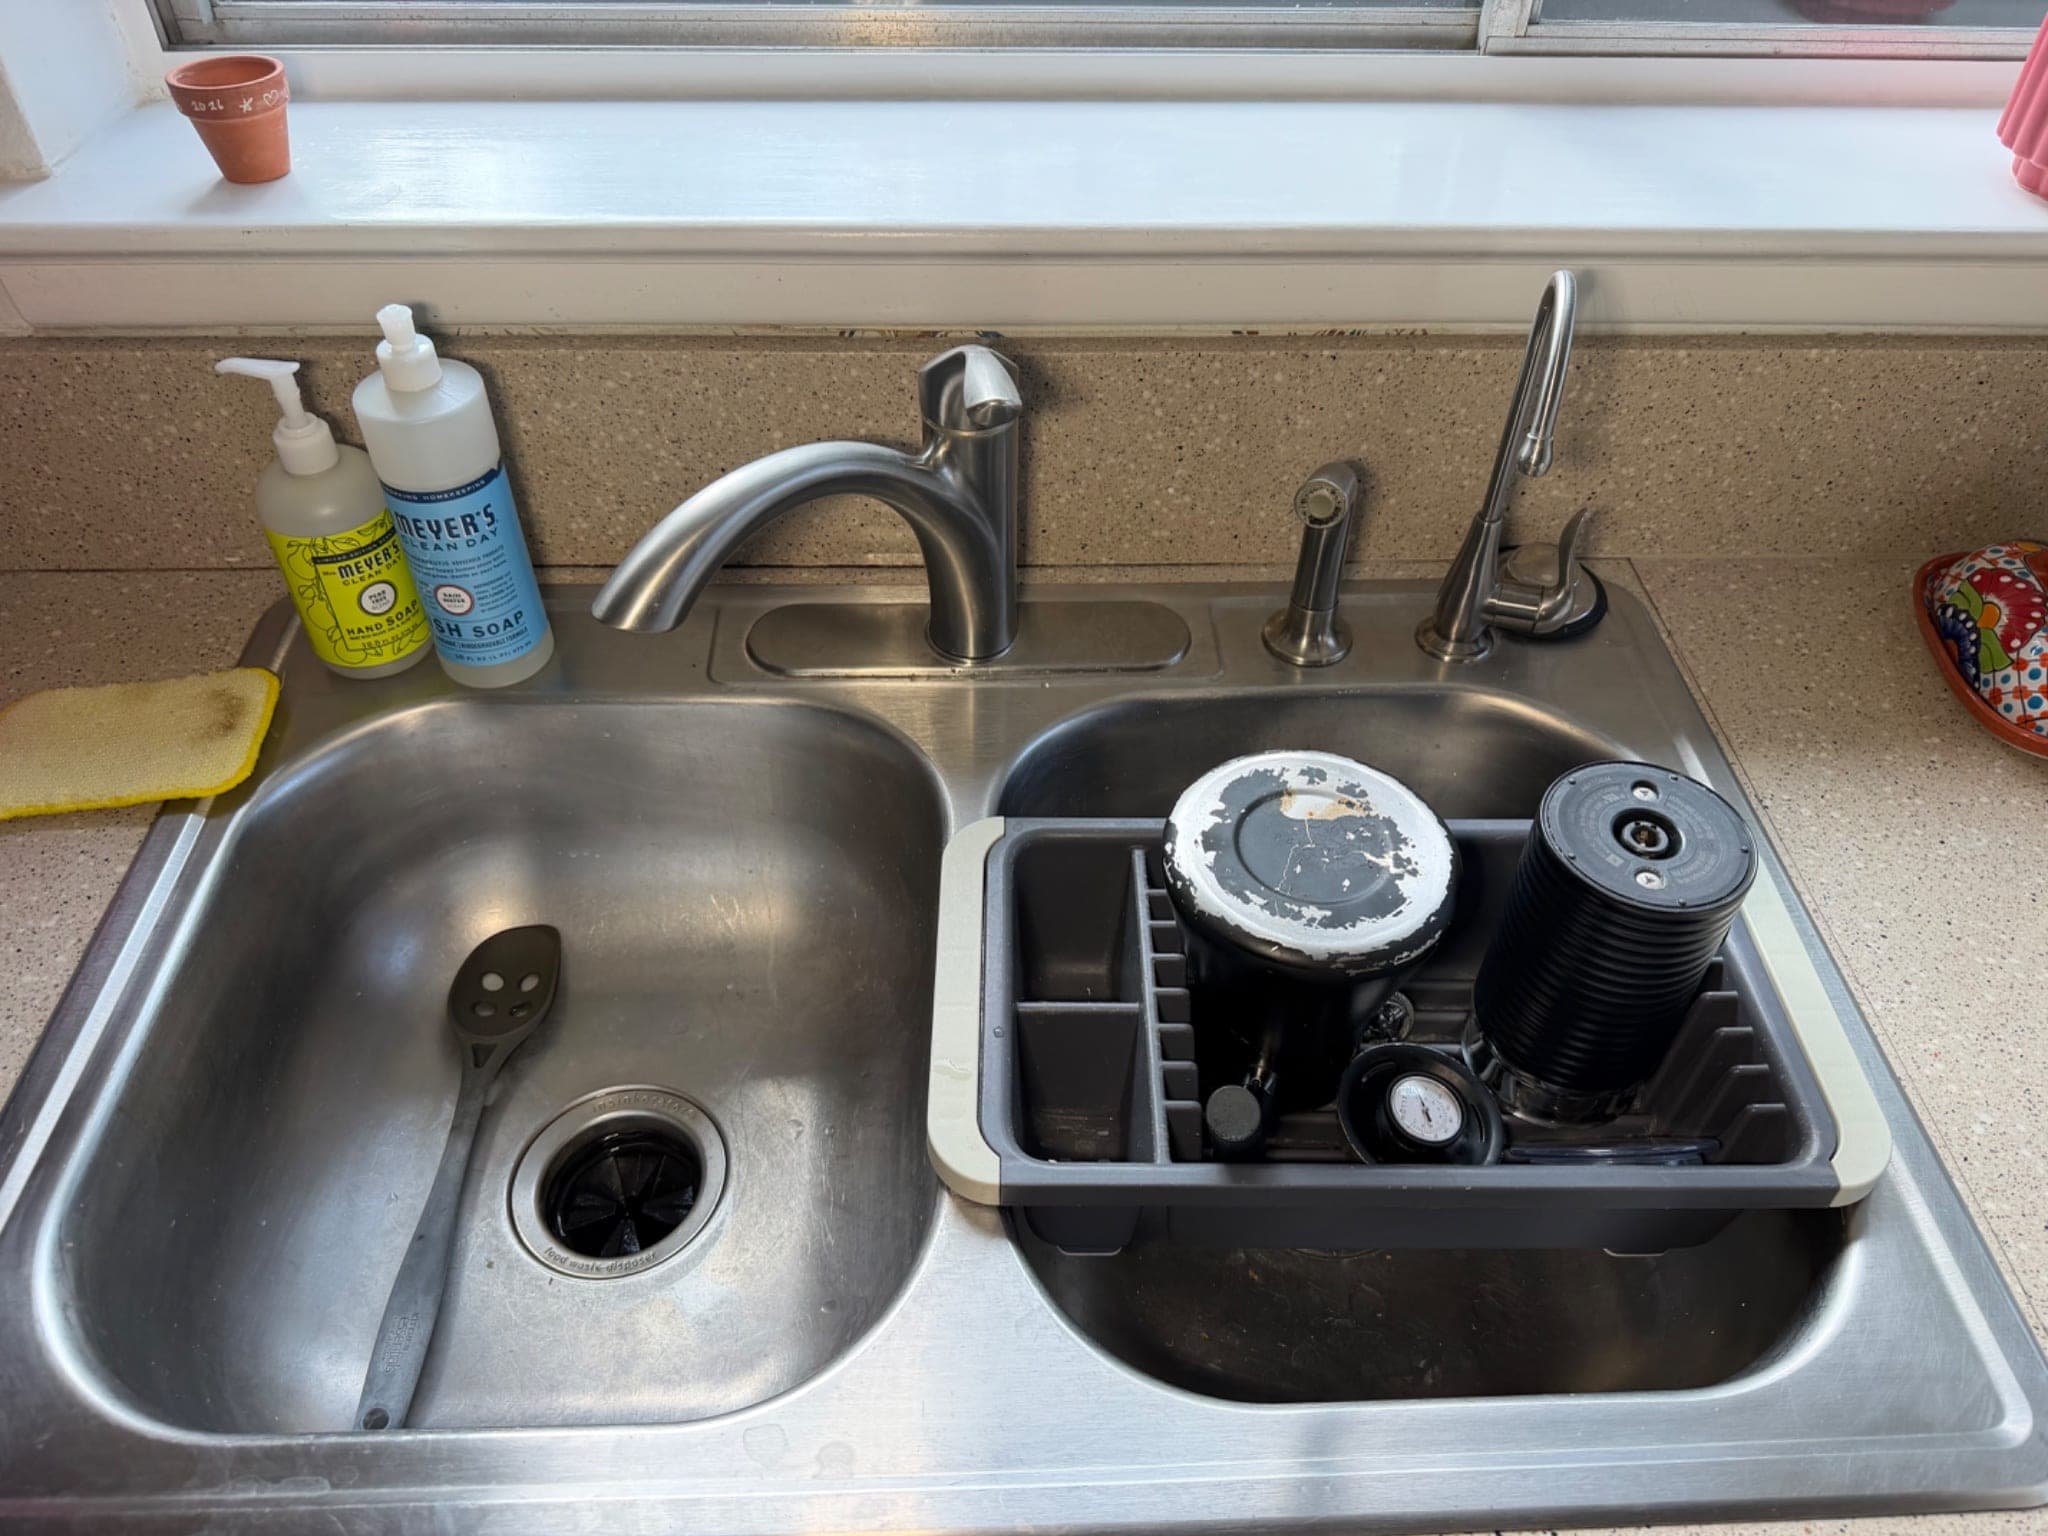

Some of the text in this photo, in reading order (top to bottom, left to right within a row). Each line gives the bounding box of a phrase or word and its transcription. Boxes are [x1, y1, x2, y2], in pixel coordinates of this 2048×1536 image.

[393, 502, 496, 541] MEYER'S
[400, 534, 458, 553] CLEAN
[466, 527, 498, 547] DAY
[337, 539, 401, 579] MEYER'S
[341, 569, 382, 587] CLEAN
[385, 554, 402, 571] DAY
[345, 622, 384, 637] HAND
[385, 598, 418, 627] SOAP
[472, 610, 524, 639] SOAP
[604, 1252, 659, 1274] disposer
